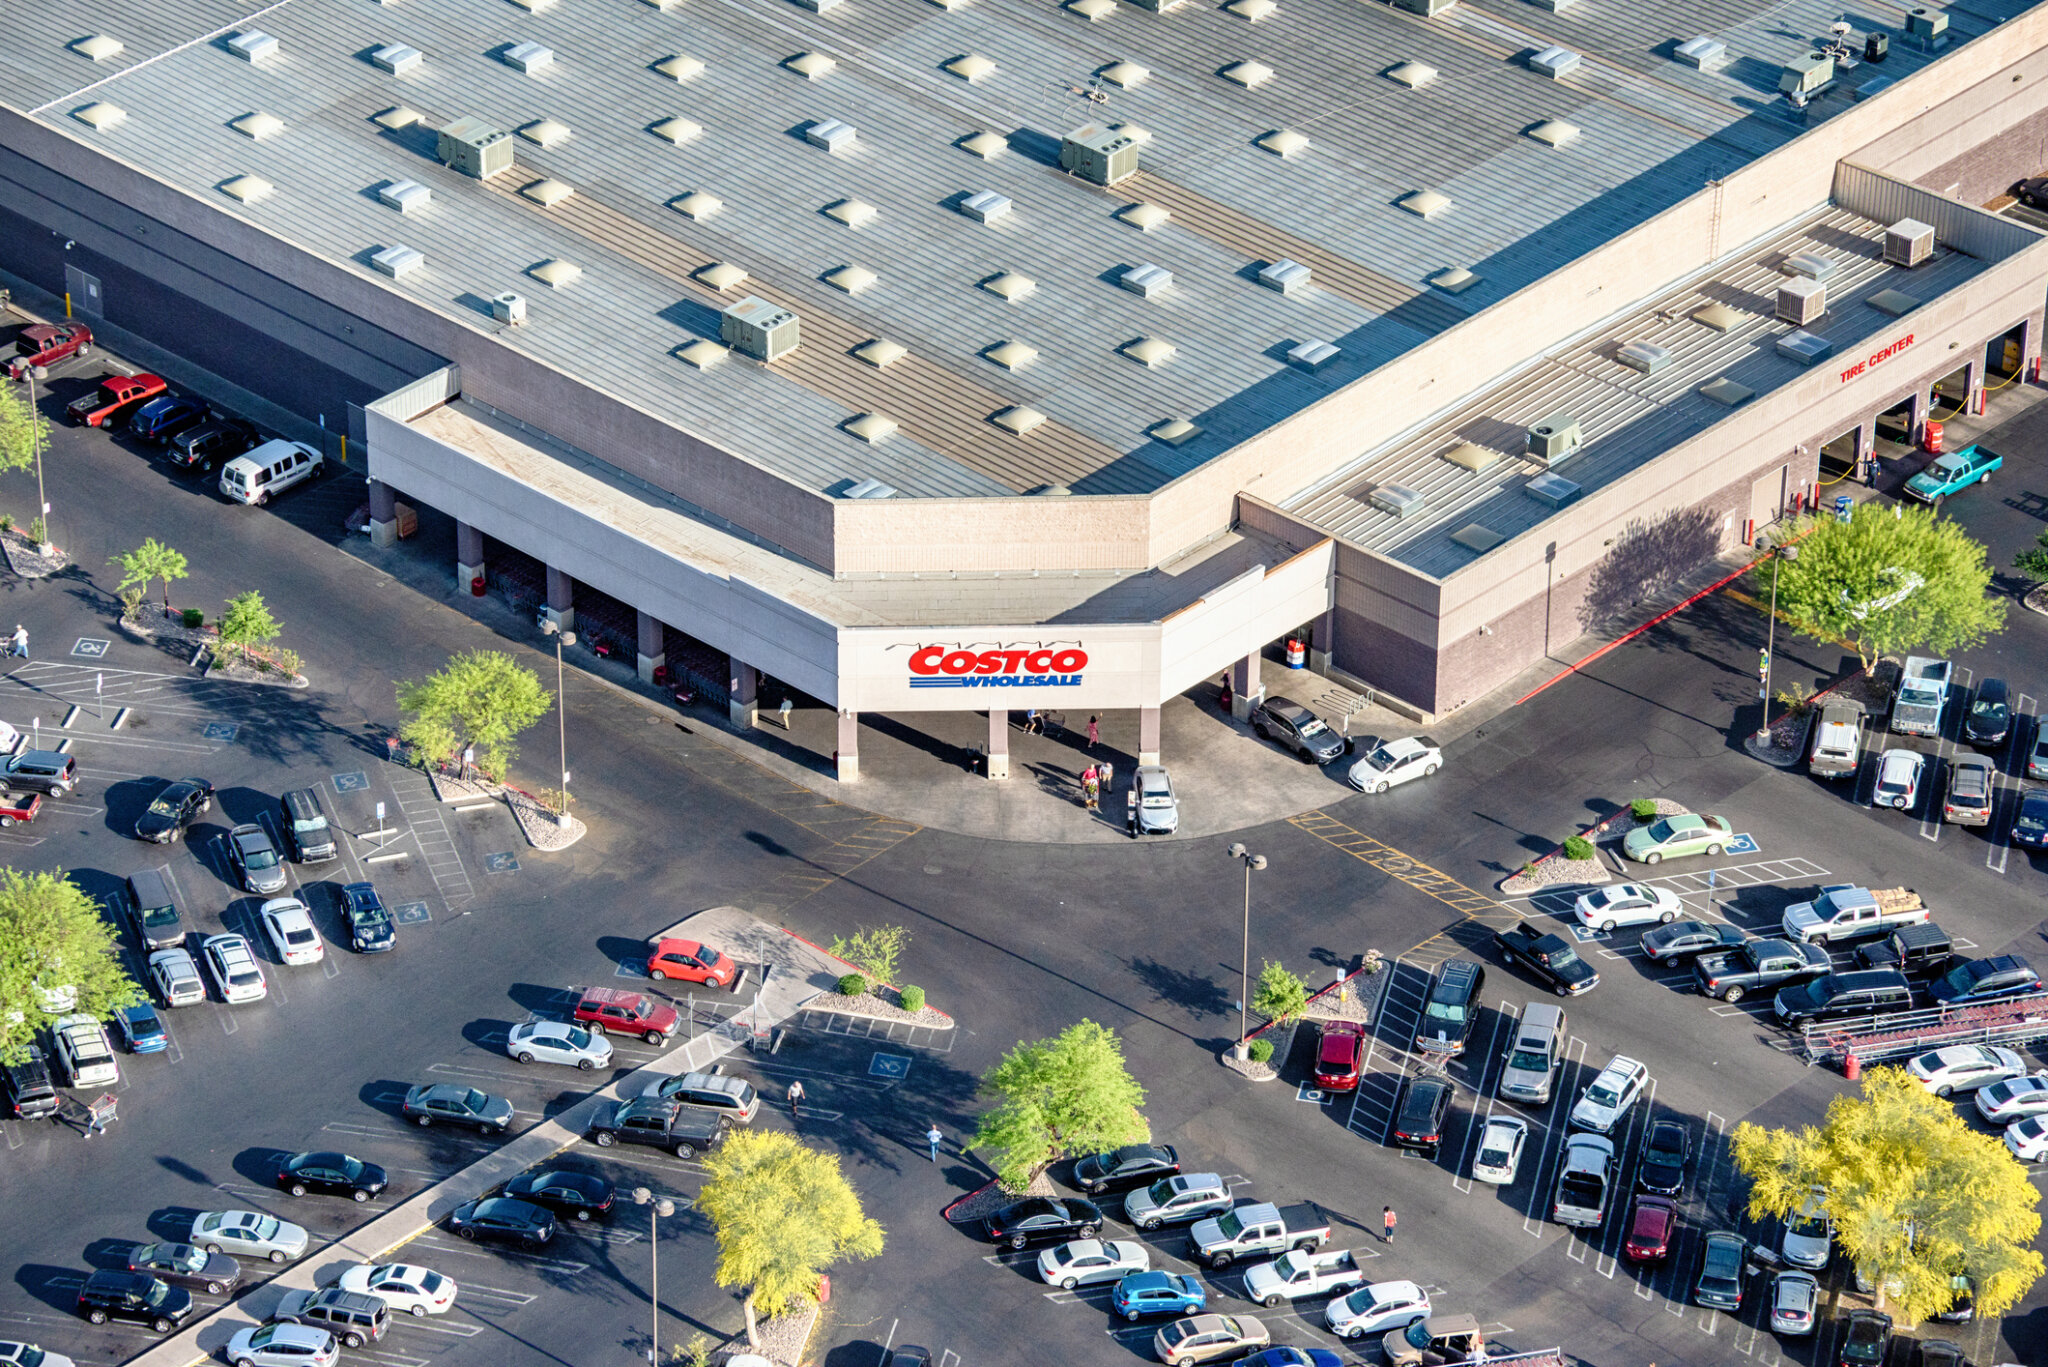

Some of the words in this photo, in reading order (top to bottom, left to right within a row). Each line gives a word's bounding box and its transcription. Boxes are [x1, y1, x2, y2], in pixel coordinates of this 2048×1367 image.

[1840, 361, 1866, 383] TIRE
[1869, 334, 1914, 367] CENTER
[909, 646, 1088, 675] COSTCO
[961, 675, 1082, 687] WHOLESALE
